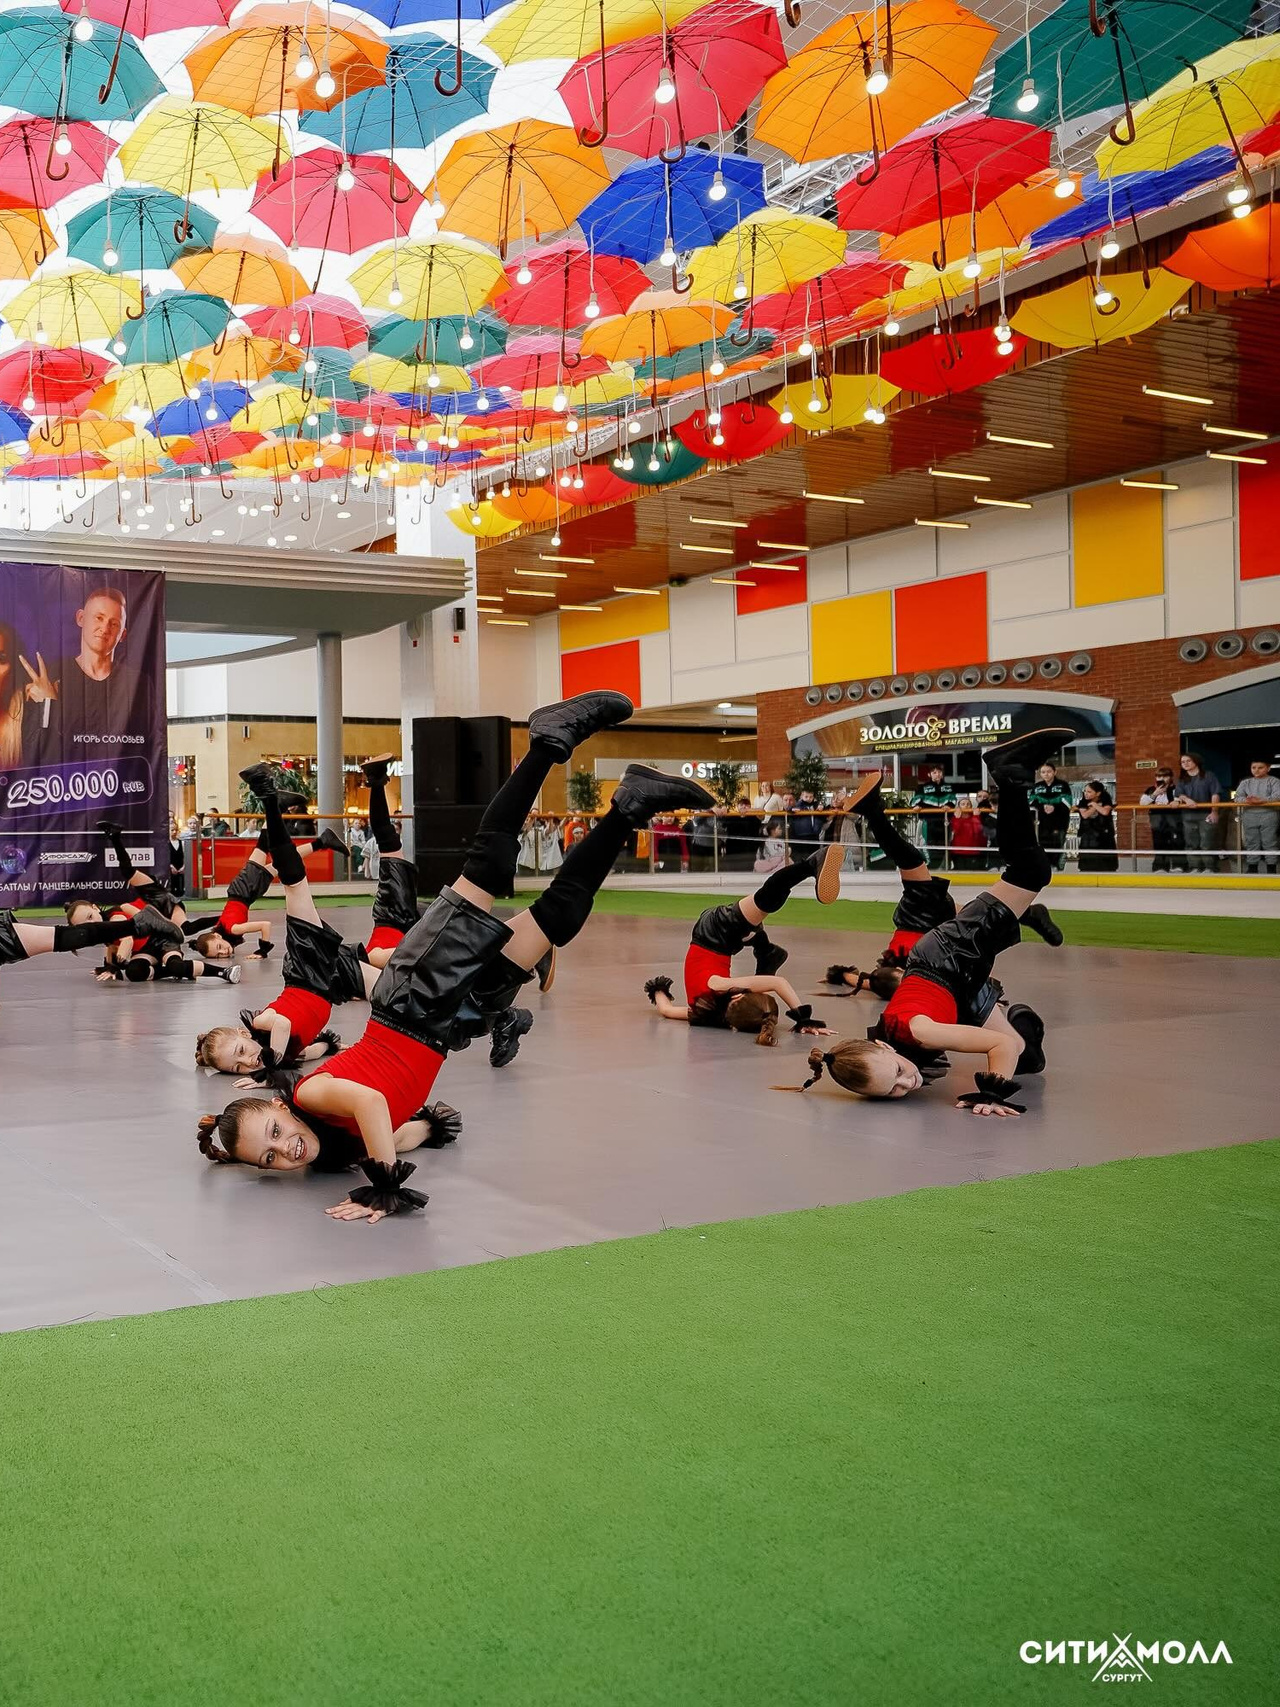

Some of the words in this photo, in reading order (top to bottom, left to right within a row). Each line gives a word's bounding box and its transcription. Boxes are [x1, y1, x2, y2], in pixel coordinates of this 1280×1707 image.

[948, 713, 1012, 735] ВРЕМЯ
[73, 735, 101, 743] ИГОРЬ
[101, 735, 145, 744] СОЛОВЬЕВ
[875, 740, 943, 751] СПЕЦИАЛИЗИРОВАННЫЙ
[945, 737, 974, 746] МАГАЗИН
[976, 735, 998, 743] ЧАСОВ
[6, 769, 119, 808] 250.000
[122, 780, 145, 793] RUB
[38, 881, 104, 891] ТАНЦЕВАЛЬНОЕ
[104, 880, 125, 889] ШОУ
